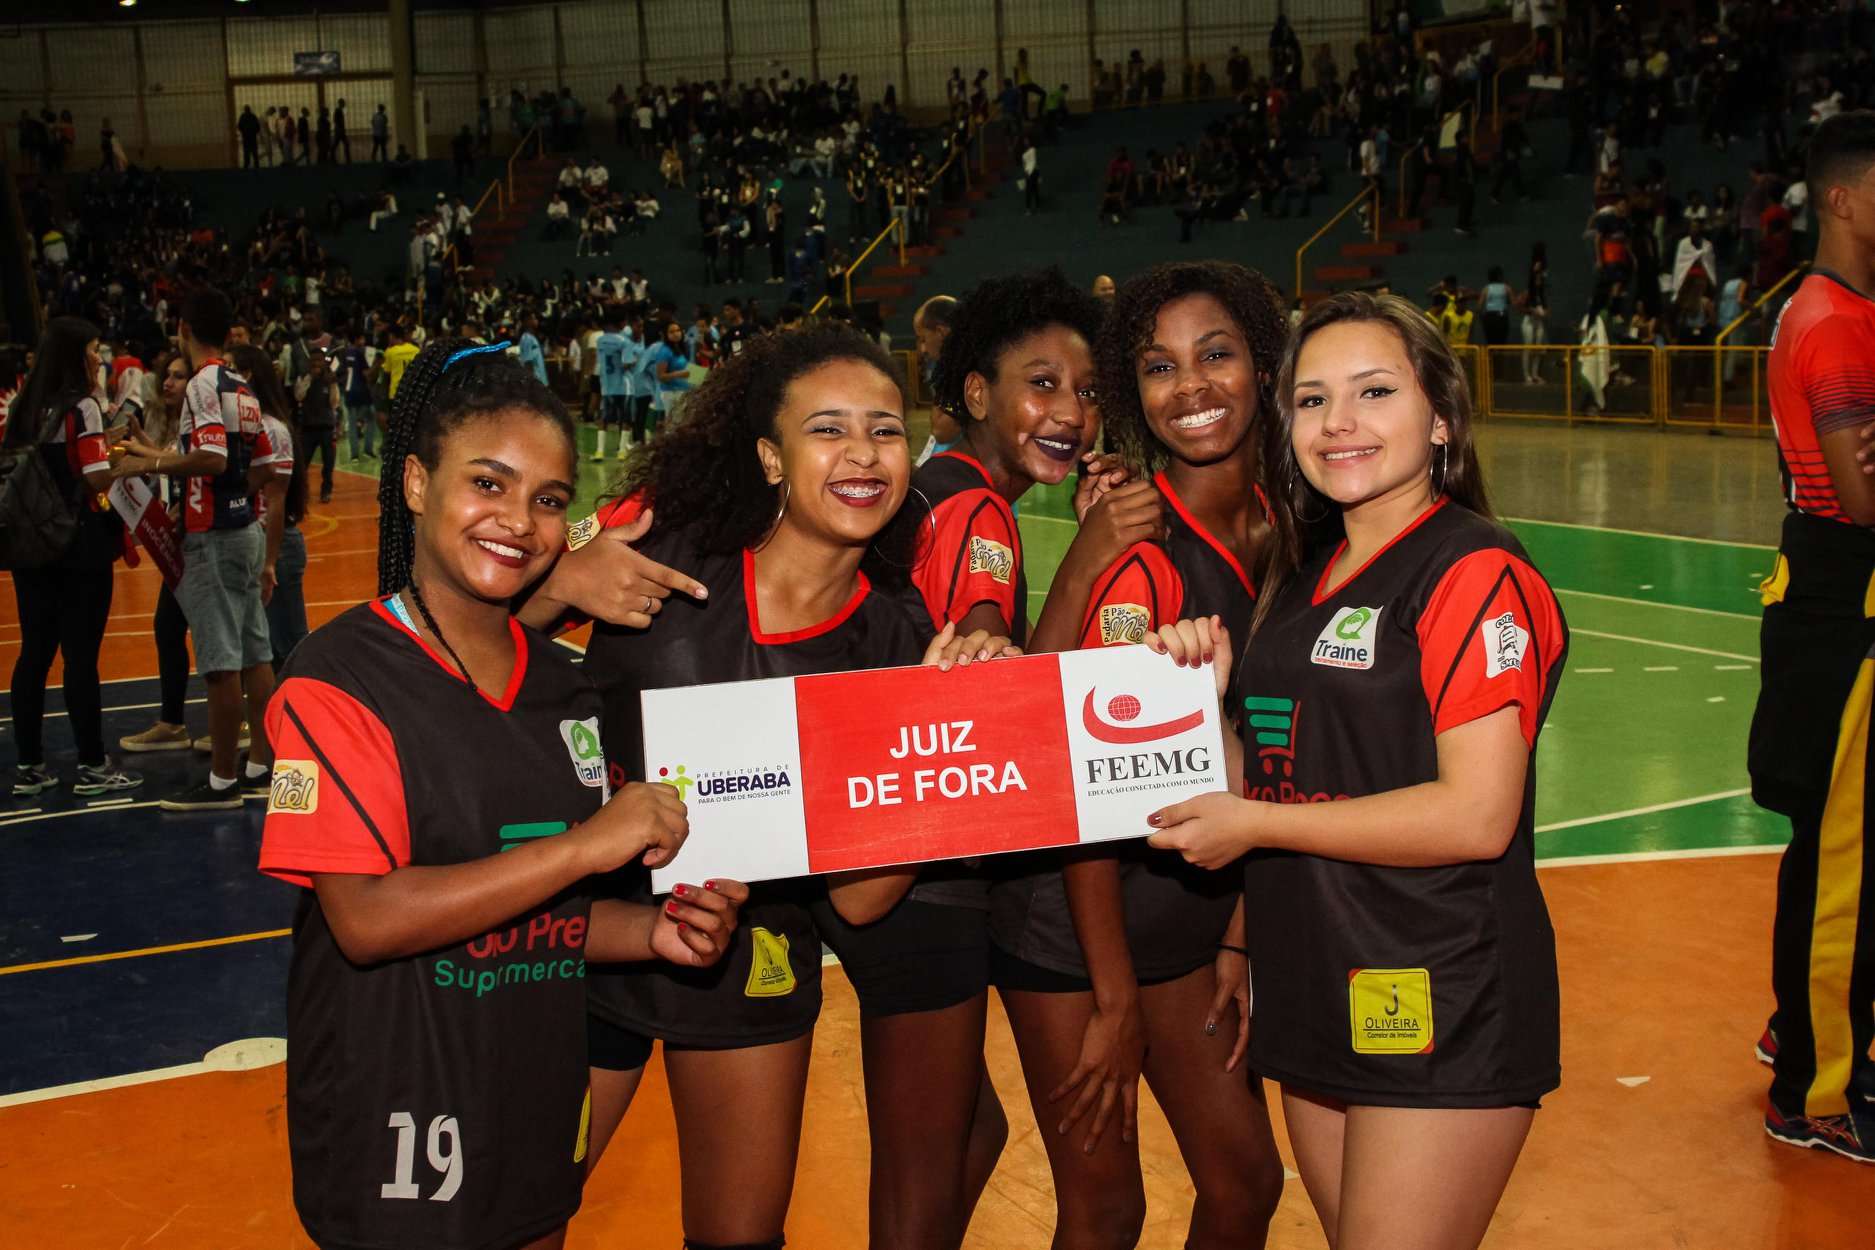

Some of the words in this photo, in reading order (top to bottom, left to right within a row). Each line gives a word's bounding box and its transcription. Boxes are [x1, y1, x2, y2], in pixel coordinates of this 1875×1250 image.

[1316, 639, 1368, 662] Traine
[889, 719, 977, 759] JUIZ
[696, 766, 769, 778] PREFEITURA
[776, 763, 789, 771] DE
[1086, 746, 1211, 784] FEEMG
[697, 771, 792, 796] UBERABA
[847, 772, 903, 809] DE
[914, 760, 1028, 802] FORA
[1087, 785, 1125, 797] EDUCAÇÃO
[1125, 782, 1166, 793] CONECTADA
[1166, 779, 1182, 789] COM
[1189, 776, 1215, 785] MUNDO
[698, 797, 715, 805] PARA
[722, 795, 737, 803] BEM
[737, 793, 746, 801] DE
[747, 791, 769, 799] NOSSA
[770, 788, 791, 797] GENTE
[1365, 1016, 1419, 1029] OLIVEIRA
[381, 1111, 464, 1202] 19
